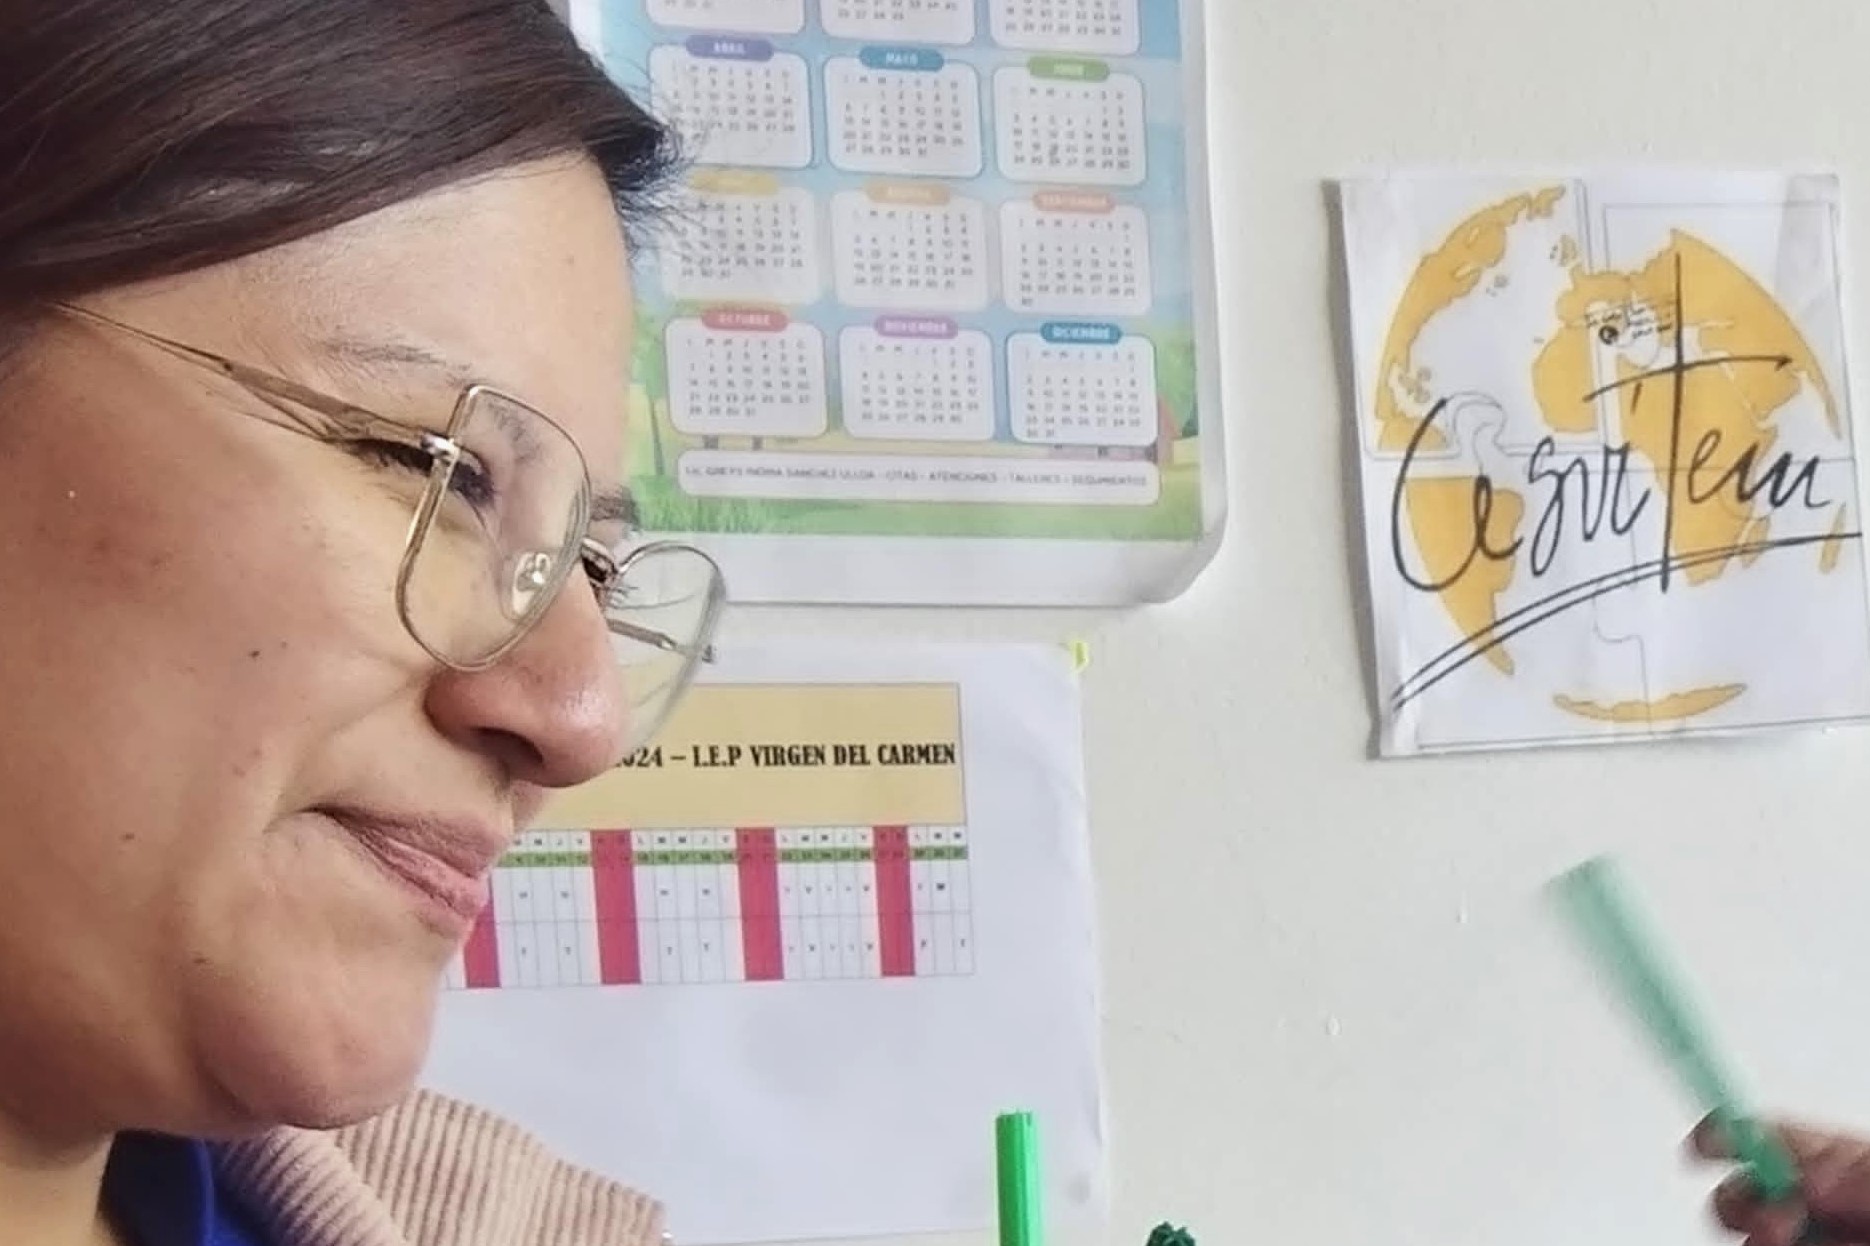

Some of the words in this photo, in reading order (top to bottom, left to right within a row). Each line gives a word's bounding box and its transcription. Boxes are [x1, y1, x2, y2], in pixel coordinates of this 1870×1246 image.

[693, 745, 742, 768] I.E.P
[750, 744, 825, 768] VIRGEN
[833, 743, 871, 767] DEL
[877, 742, 956, 766] CARMEN
